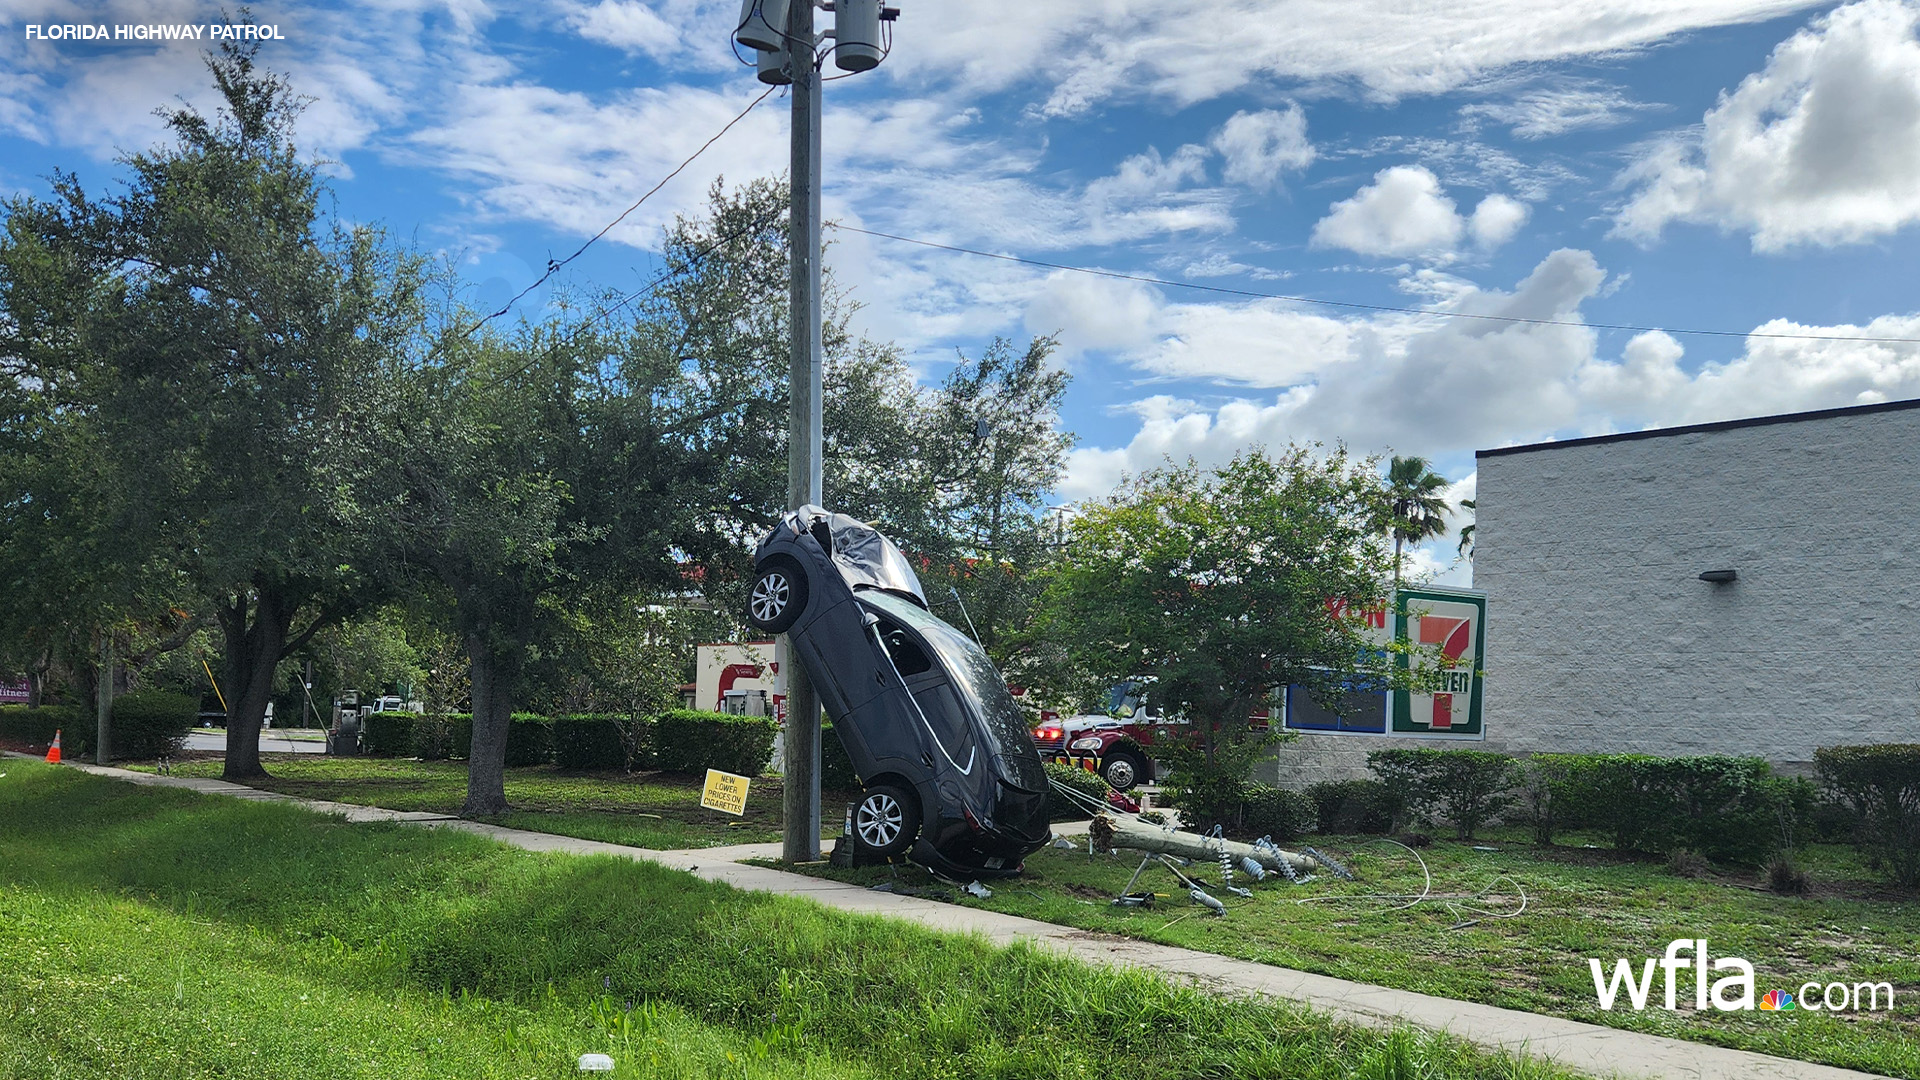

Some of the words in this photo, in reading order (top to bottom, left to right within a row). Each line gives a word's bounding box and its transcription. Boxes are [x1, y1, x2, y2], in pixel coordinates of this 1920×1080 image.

[1419, 616, 1471, 727] 7
[721, 775, 736, 784] NEW
[715, 782, 738, 794] LOWER
[708, 789, 731, 801] PRICES
[732, 795, 742, 804] ON
[703, 797, 742, 813] CIGARETTES
